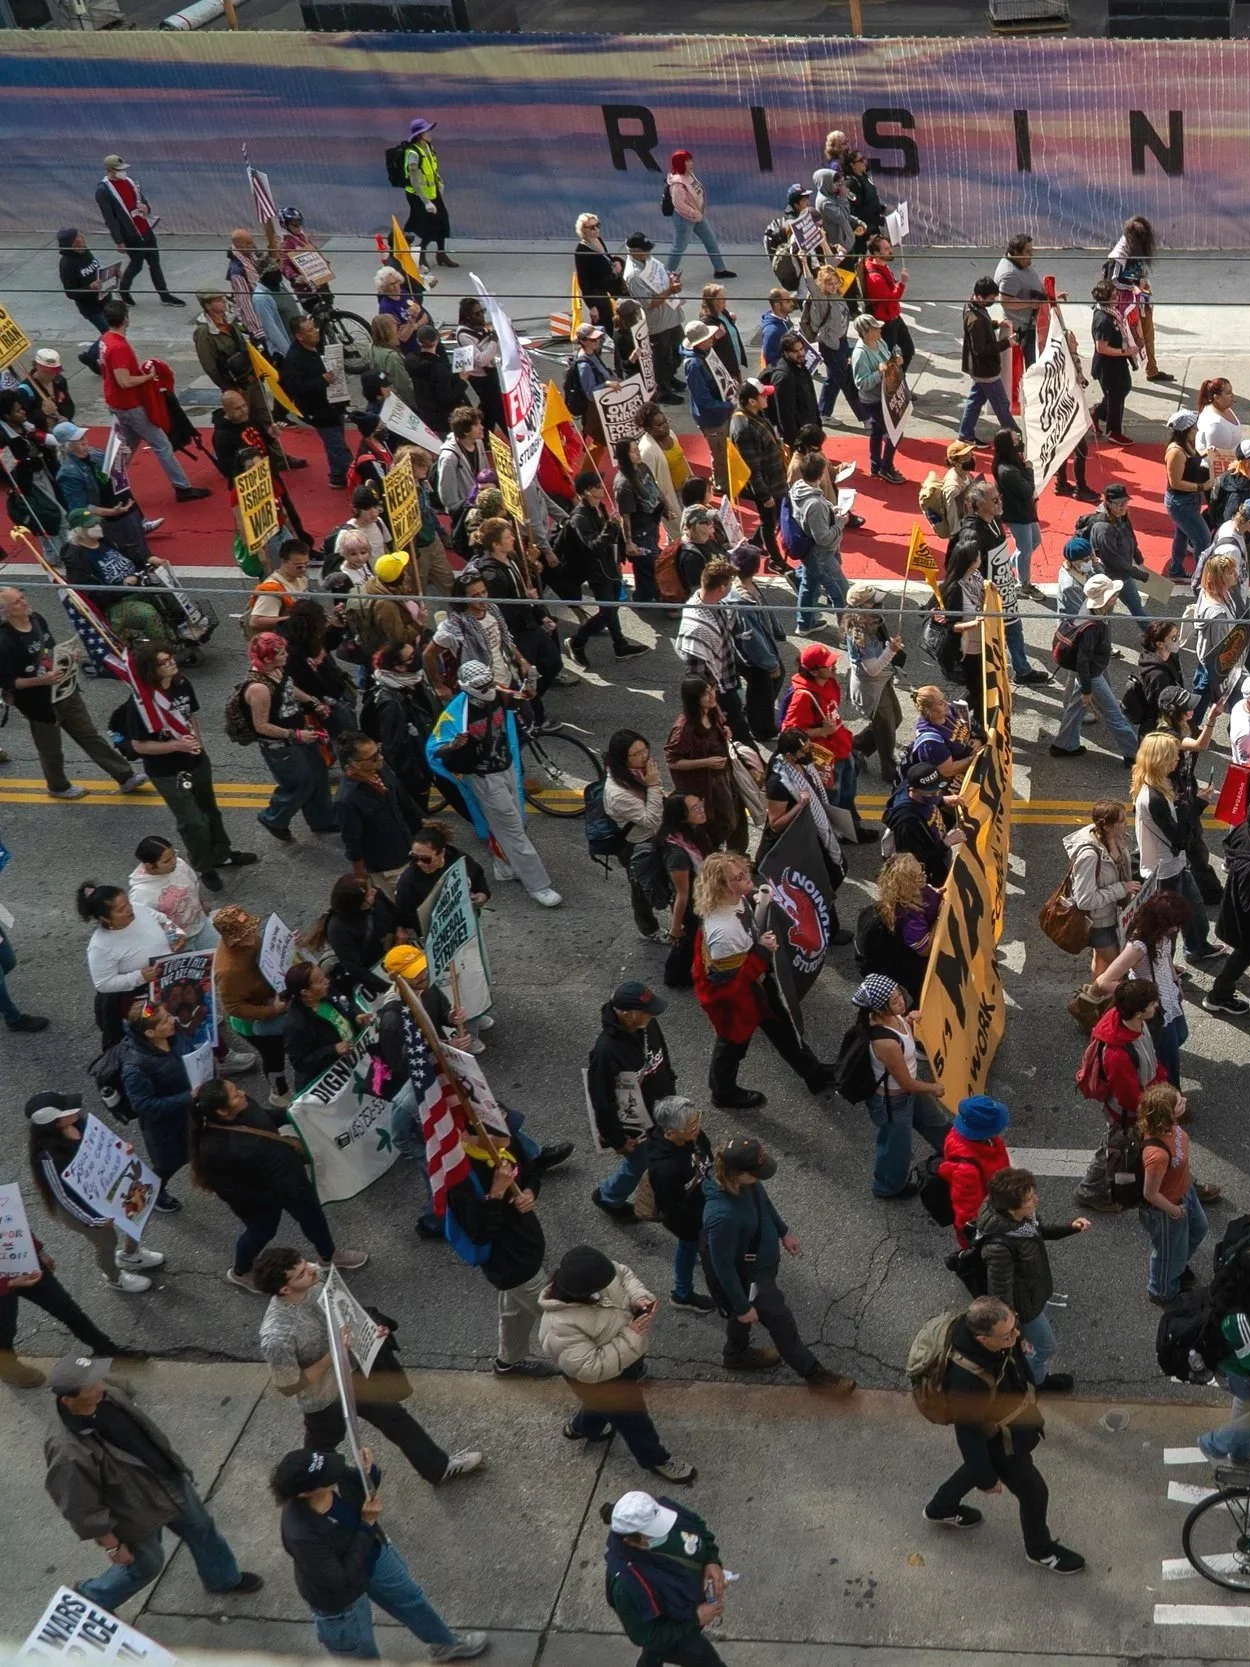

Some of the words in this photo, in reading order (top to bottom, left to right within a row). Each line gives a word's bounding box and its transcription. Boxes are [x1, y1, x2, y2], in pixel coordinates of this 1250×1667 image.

[238, 470, 258, 494] STOP
[243, 477, 272, 513] ISRAELI
[248, 500, 275, 540] WAR
[438, 890, 463, 927] TRUMP
[791, 871, 830, 927] UNION
[432, 907, 467, 959] GENERAL
[434, 922, 469, 978] STRIKE!
[36, 1593, 87, 1651] WARS
[77, 1610, 120, 1654] ICE
